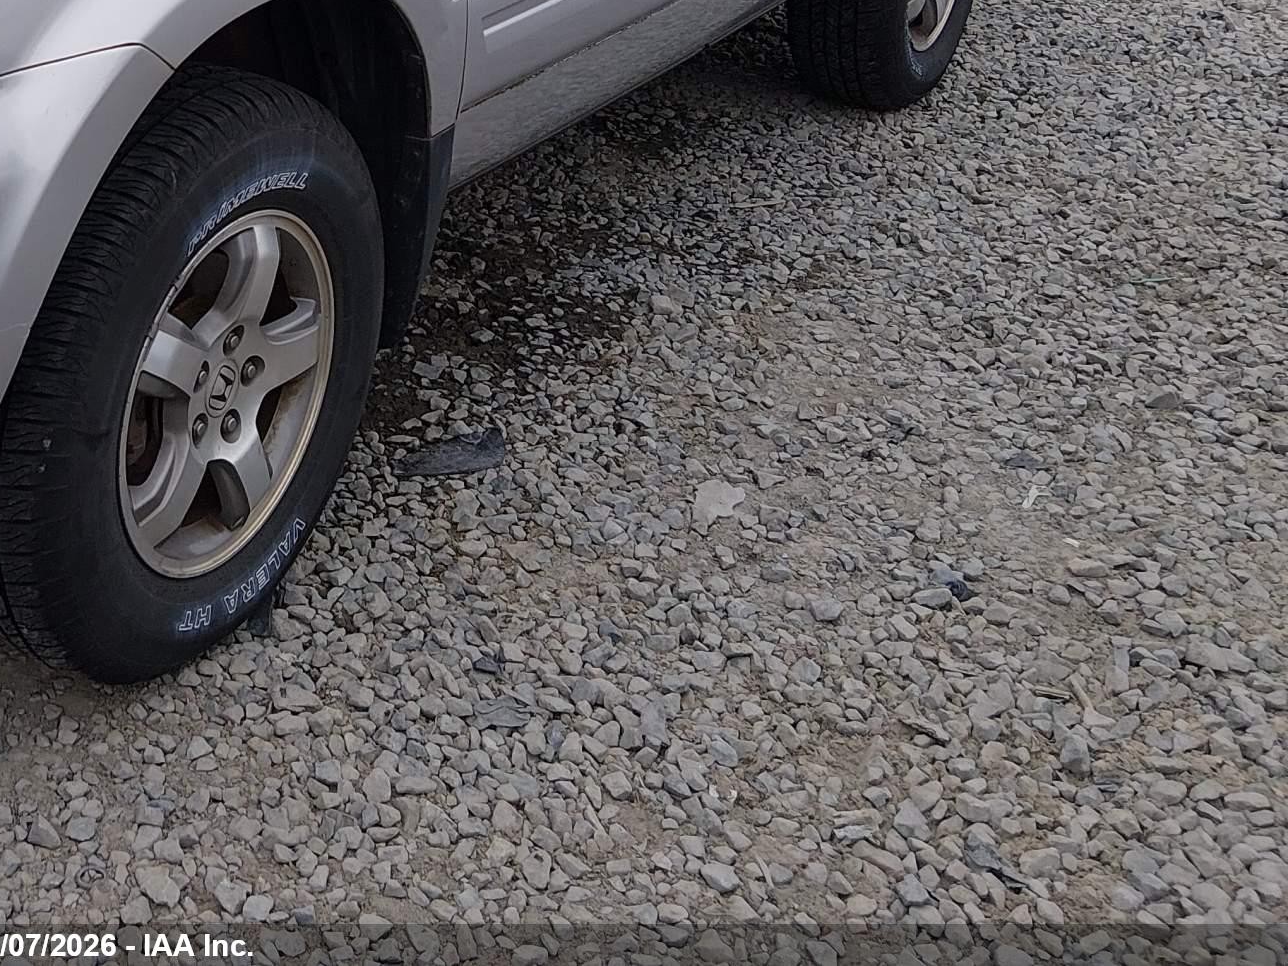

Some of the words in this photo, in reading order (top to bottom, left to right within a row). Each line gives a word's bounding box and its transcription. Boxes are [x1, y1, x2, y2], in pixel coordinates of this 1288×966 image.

[186, 171, 309, 257] PRIMEWELL
[223, 517, 306, 614] VALERA
[178, 604, 212, 631] HT
